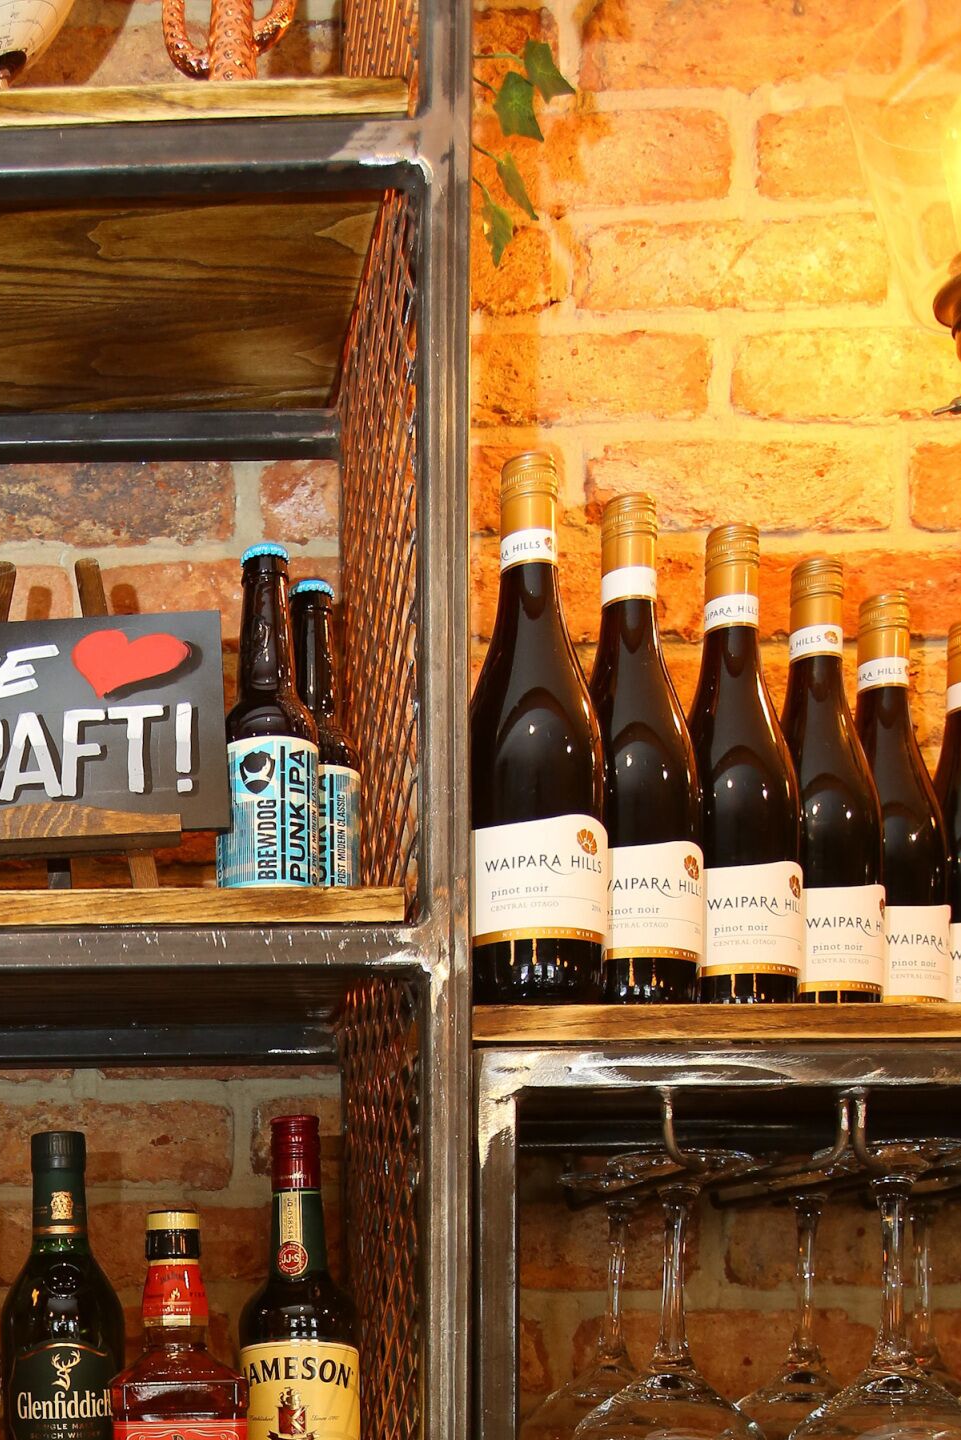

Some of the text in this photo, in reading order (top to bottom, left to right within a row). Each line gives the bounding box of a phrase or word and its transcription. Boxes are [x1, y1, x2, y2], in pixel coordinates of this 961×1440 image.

[513, 541, 540, 552] HILLS
[796, 635, 821, 648] HILLS
[878, 667, 902, 676] HILLS
[289, 750, 305, 883] PUNK IPA
[257, 799, 277, 880] BREWDOG
[337, 794, 346, 884] POST MODERN CLASSIC
[485, 854, 602, 874] WAIPARA HILLS
[491, 884, 548, 899] pinot noir
[607, 878, 674, 898] AIPARA
[491, 901, 559, 912] CENTRAL OTAGO
[637, 906, 660, 914] noir
[707, 896, 783, 916] WAIPARA
[608, 922, 640, 931] ENTRAL
[714, 923, 769, 935] pinot noir
[806, 917, 874, 937] WAIPARA
[813, 944, 841, 954] pinot
[886, 934, 944, 954] WAIPARA
[891, 959, 937, 969] pinot noir
[17, 1389, 111, 1419] Glenfiddich
